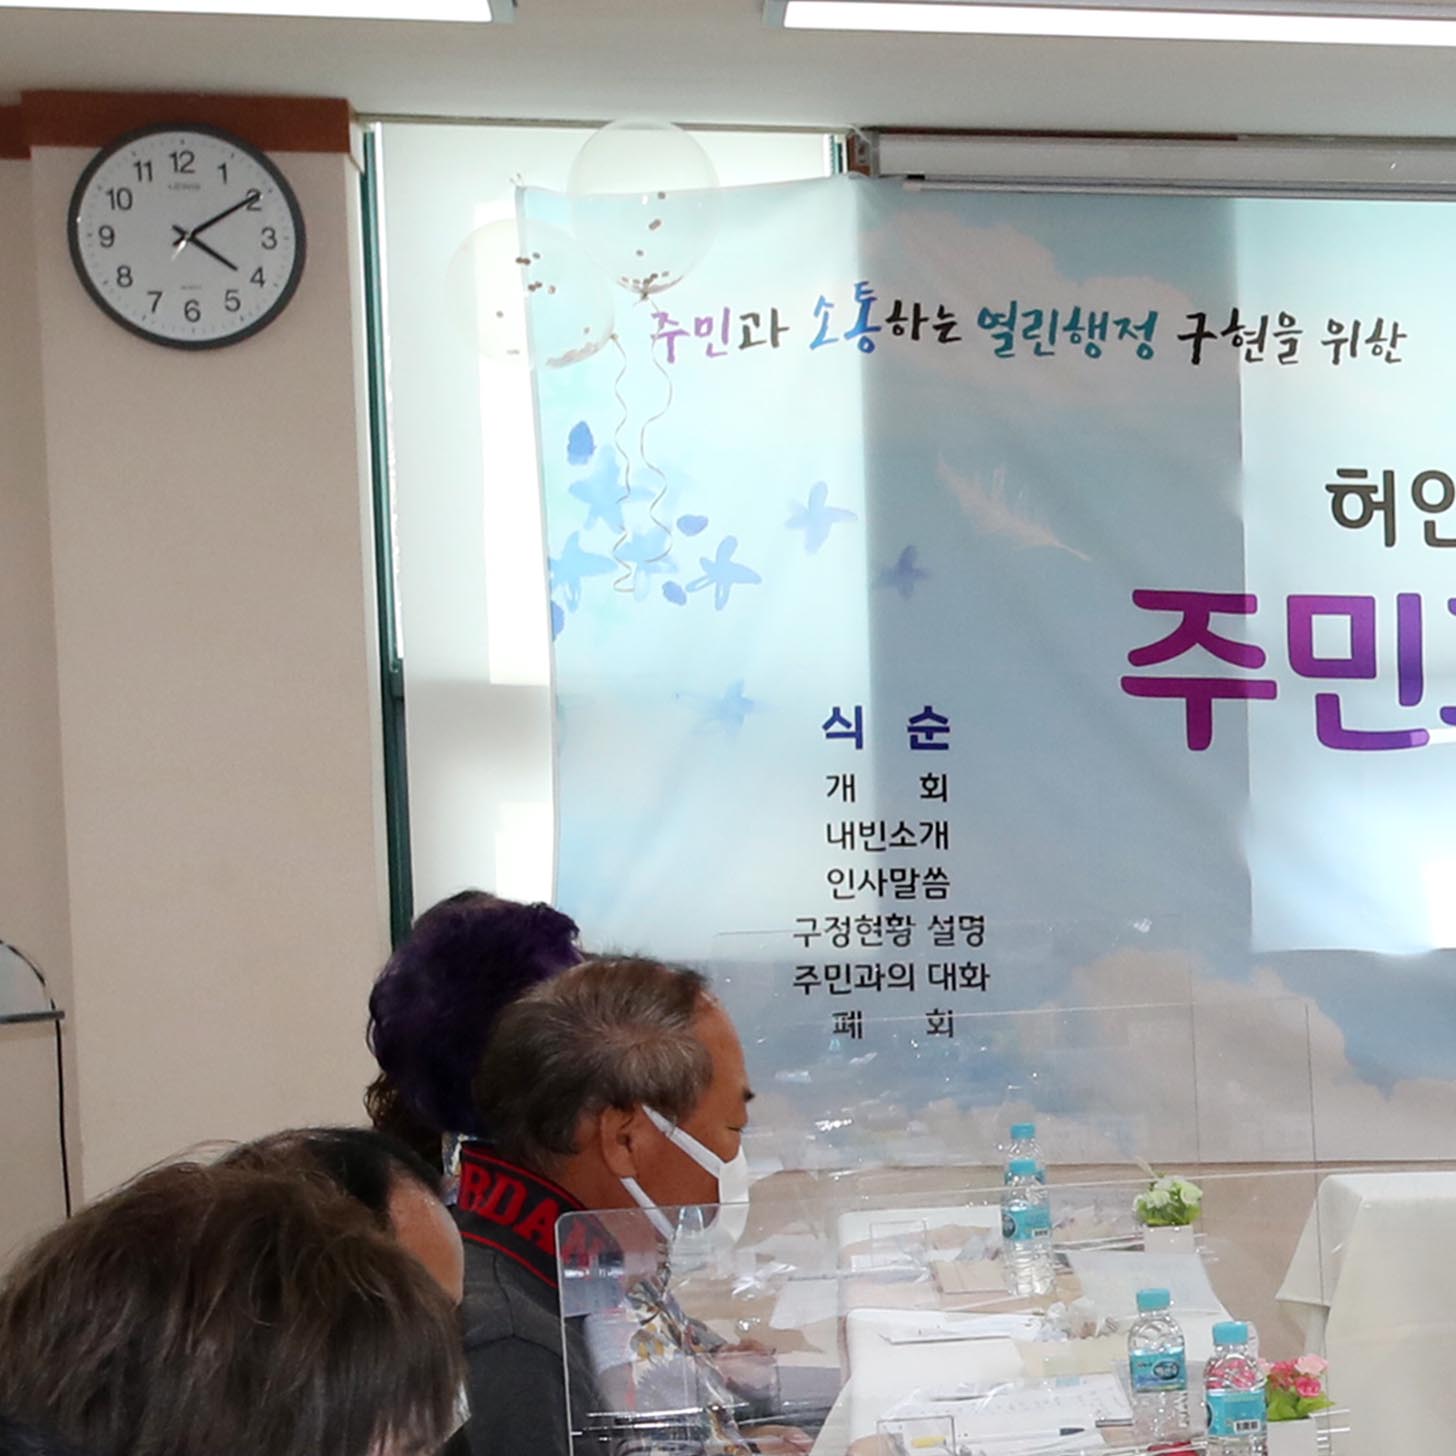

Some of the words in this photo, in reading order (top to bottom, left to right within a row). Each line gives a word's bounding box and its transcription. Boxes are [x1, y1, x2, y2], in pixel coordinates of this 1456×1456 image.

[133, 161, 153, 183] 11
[169, 150, 195, 174] 12
[217, 163, 228, 184] 1
[106, 187, 133, 211] 10
[246, 188, 262, 211] 2
[98, 225, 115, 248] 9
[261, 227, 278, 250] 3
[116, 265, 133, 288] 8
[250, 266, 266, 288] 4
[147, 290, 163, 314] 7
[184, 299, 200, 323] 6
[224, 289, 241, 312] 5
[651, 307, 790, 364] 주민과
[809, 279, 963, 354] 소통하는
[977, 298, 1159, 361] 열린행정
[1176, 306, 1304, 366] 구현을
[1320, 317, 1409, 366] 위한
[826, 820, 949, 852] 내빈소개
[826, 866, 950, 900] 인사말씀
[793, 912, 917, 949] 구정현황
[927, 914, 986, 948] 설명
[793, 962, 915, 996] 주민과의
[928, 961, 990, 992] 대화
